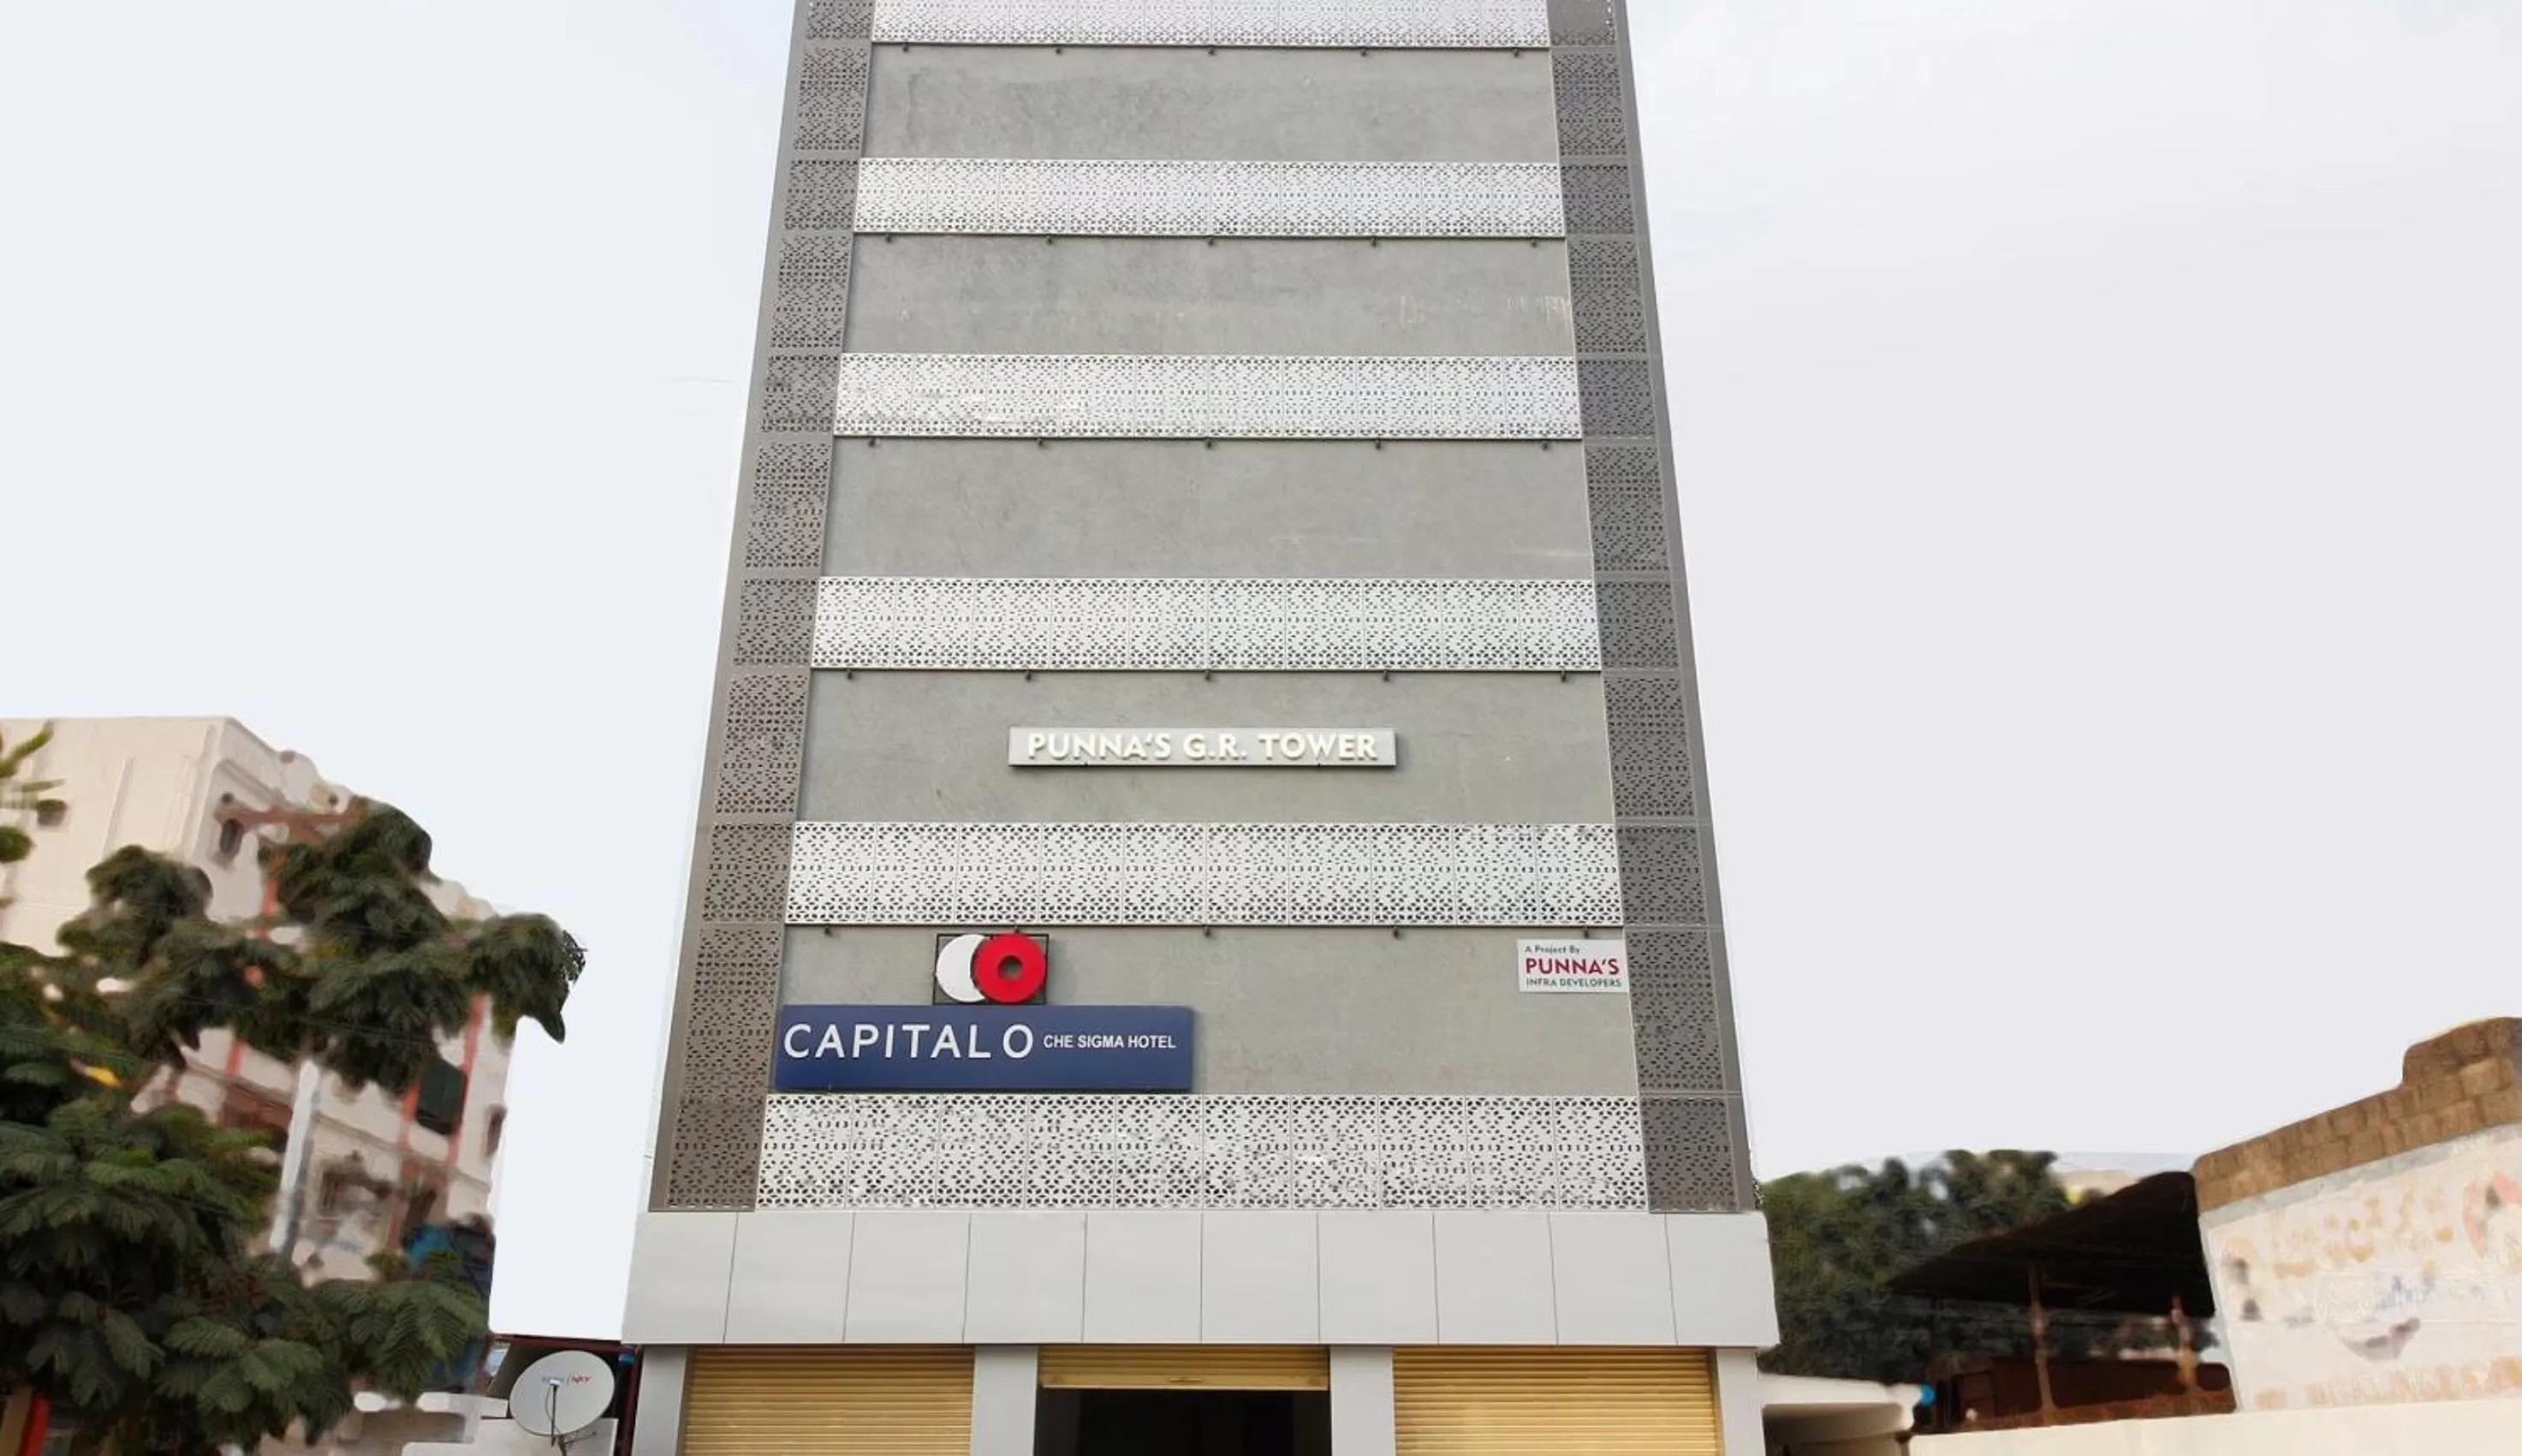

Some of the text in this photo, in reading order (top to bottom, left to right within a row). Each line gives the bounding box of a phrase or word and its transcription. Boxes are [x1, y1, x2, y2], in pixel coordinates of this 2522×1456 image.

[1028, 733, 1378, 761] PUNNA'S G.R. TOWER
[1535, 945, 1567, 954] Project
[1569, 945, 1580, 954] By
[1526, 957, 1620, 975] PUNNA'S
[1526, 978, 1622, 988] INFRA DEVELOPERS
[783, 1024, 1176, 1059] CAPITAL O CHE SIGMA HOTEL
